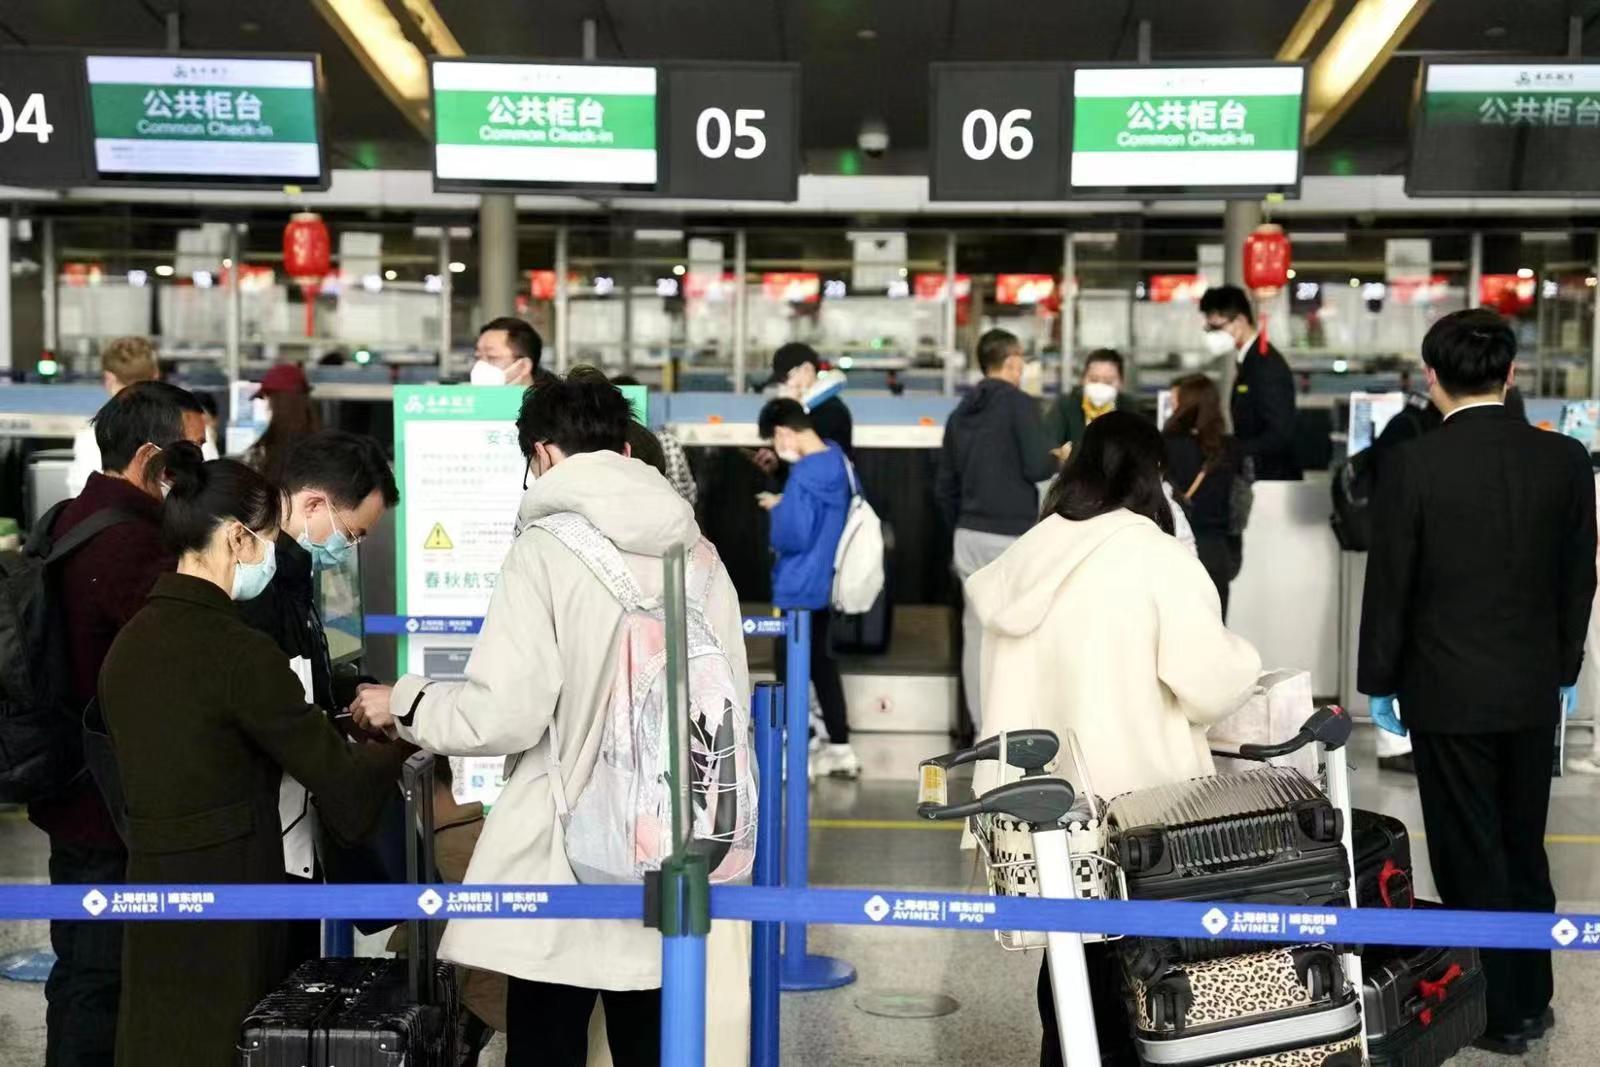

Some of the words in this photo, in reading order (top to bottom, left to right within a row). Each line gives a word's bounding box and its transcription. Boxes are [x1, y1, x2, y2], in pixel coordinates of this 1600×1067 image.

[143, 89, 263, 121] 公共柜台
[486, 95, 604, 127] 公共柜台
[1126, 100, 1247, 130] 公共柜台
[137, 120, 205, 135] Common
[207, 121, 274, 136] Check-in
[479, 125, 546, 142] Common
[549, 127, 614, 144] Check-in
[696, 107, 767, 160] 05
[962, 108, 1034, 161] 06
[1116, 131, 1185, 147] Common
[1187, 130, 1255, 147] Check-in
[111, 904, 158, 913] AVINEX
[178, 904, 204, 913] PVG
[446, 903, 492, 912] AVINEX
[511, 904, 537, 913] PVG
[892, 911, 939, 921] AVINEX
[959, 913, 985, 923] PVG
[1231, 923, 1278, 933] AVINEX
[1299, 925, 1326, 935] PVG
